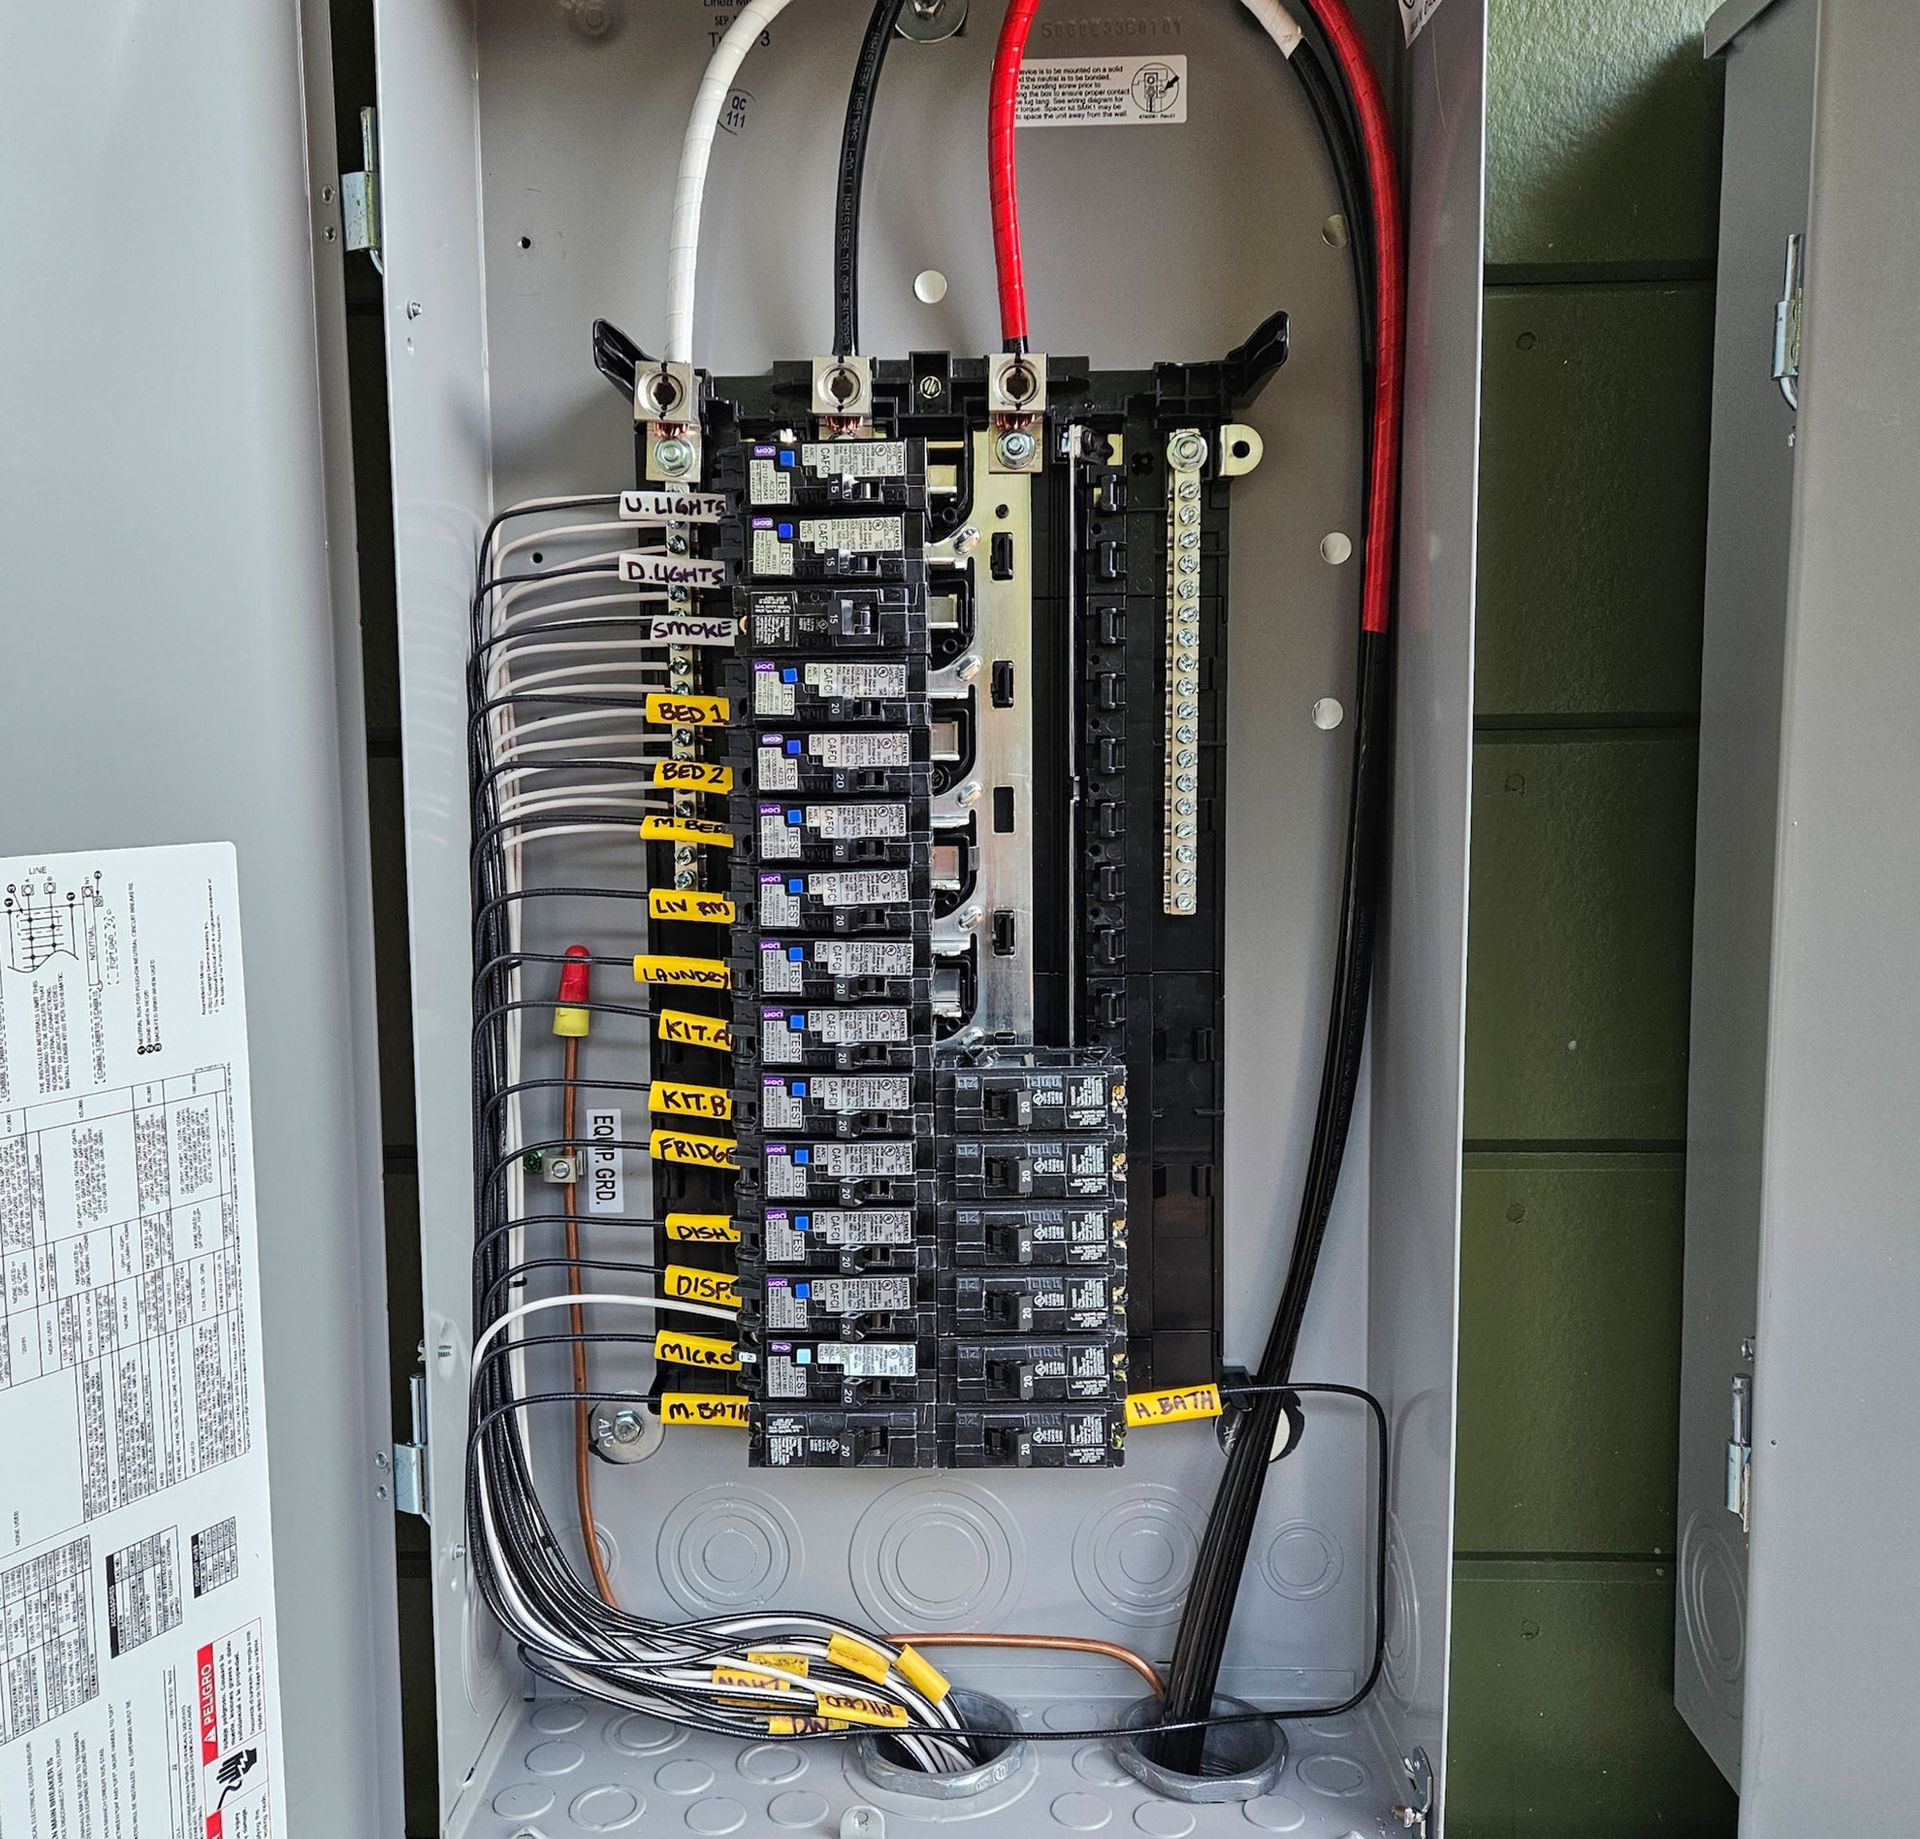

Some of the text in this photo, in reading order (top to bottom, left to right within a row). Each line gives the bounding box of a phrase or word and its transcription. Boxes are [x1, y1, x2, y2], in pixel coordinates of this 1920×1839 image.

[1063, 66, 1091, 74] mounted
[1067, 98, 1086, 106] wiring
[1088, 96, 1113, 104] diagram
[1107, 88, 1129, 96] contact
[731, 95, 747, 111] QC
[726, 110, 746, 129] 111
[1068, 112, 1085, 120] away
[841, 298, 850, 345] GASOLINE
[848, 92, 865, 140] SUNLIGHT
[779, 475, 787, 501] TEST
[831, 479, 839, 493] 15
[782, 546, 790, 573] TEST
[826, 557, 835, 567] 15
[829, 614, 838, 624] 15
[652, 620, 732, 639] SMOKE
[823, 667, 833, 693] CAFCI
[783, 686, 793, 713] TEST
[831, 703, 840, 714] 20
[658, 702, 730, 724] BED 1
[828, 737, 836, 763] CAFCI
[661, 762, 725, 784] BED 2
[787, 761, 796, 788] TEST
[836, 773, 844, 788] 20
[825, 809, 834, 835] CAFCI
[789, 829, 798, 855] TEST
[835, 845, 843, 856] 20
[29, 866, 46, 875] LINE
[827, 876, 836, 902] CAFCI
[656, 898, 687, 914] LIV
[789, 899, 798, 924] TEST
[835, 915, 844, 926] 20
[832, 945, 841, 970] CAFCI
[791, 964, 800, 989] TEST
[837, 983, 845, 995] 20
[826, 1013, 835, 1039] CAFCI
[791, 1034, 800, 1060] TEST
[838, 1053, 847, 1064] 20
[828, 1081, 837, 1106] CAFCI
[791, 1100, 800, 1126] TEST
[1021, 1102, 1030, 1113] 20
[839, 1120, 847, 1132] 20
[832, 1148, 841, 1173] CAFCI
[795, 1169, 804, 1195] TEST
[1022, 1170, 1031, 1182] 20
[594, 1168, 616, 1205] GRD.
[842, 1188, 851, 1199] 20
[831, 1216, 840, 1240] CAFCI
[794, 1233, 802, 1260] TEST
[1021, 1241, 1030, 1252] 20
[842, 1256, 850, 1268] 20
[830, 1283, 838, 1308] CAFCI
[796, 1301, 804, 1326] TEST
[1023, 1307, 1032, 1319] 20
[842, 1324, 851, 1335] 20
[660, 1343, 736, 1365] MICRO
[796, 1370, 805, 1395] TEST
[1024, 1375, 1032, 1388] 20
[844, 1389, 852, 1403] 20
[841, 1445, 849, 1457] 20
[1021, 1444, 1030, 1455] 20
[201, 1664, 215, 1726] PELIGRO
[47, 1769, 56, 1807] BREAKER
[49, 1809, 58, 1829] MAIN
